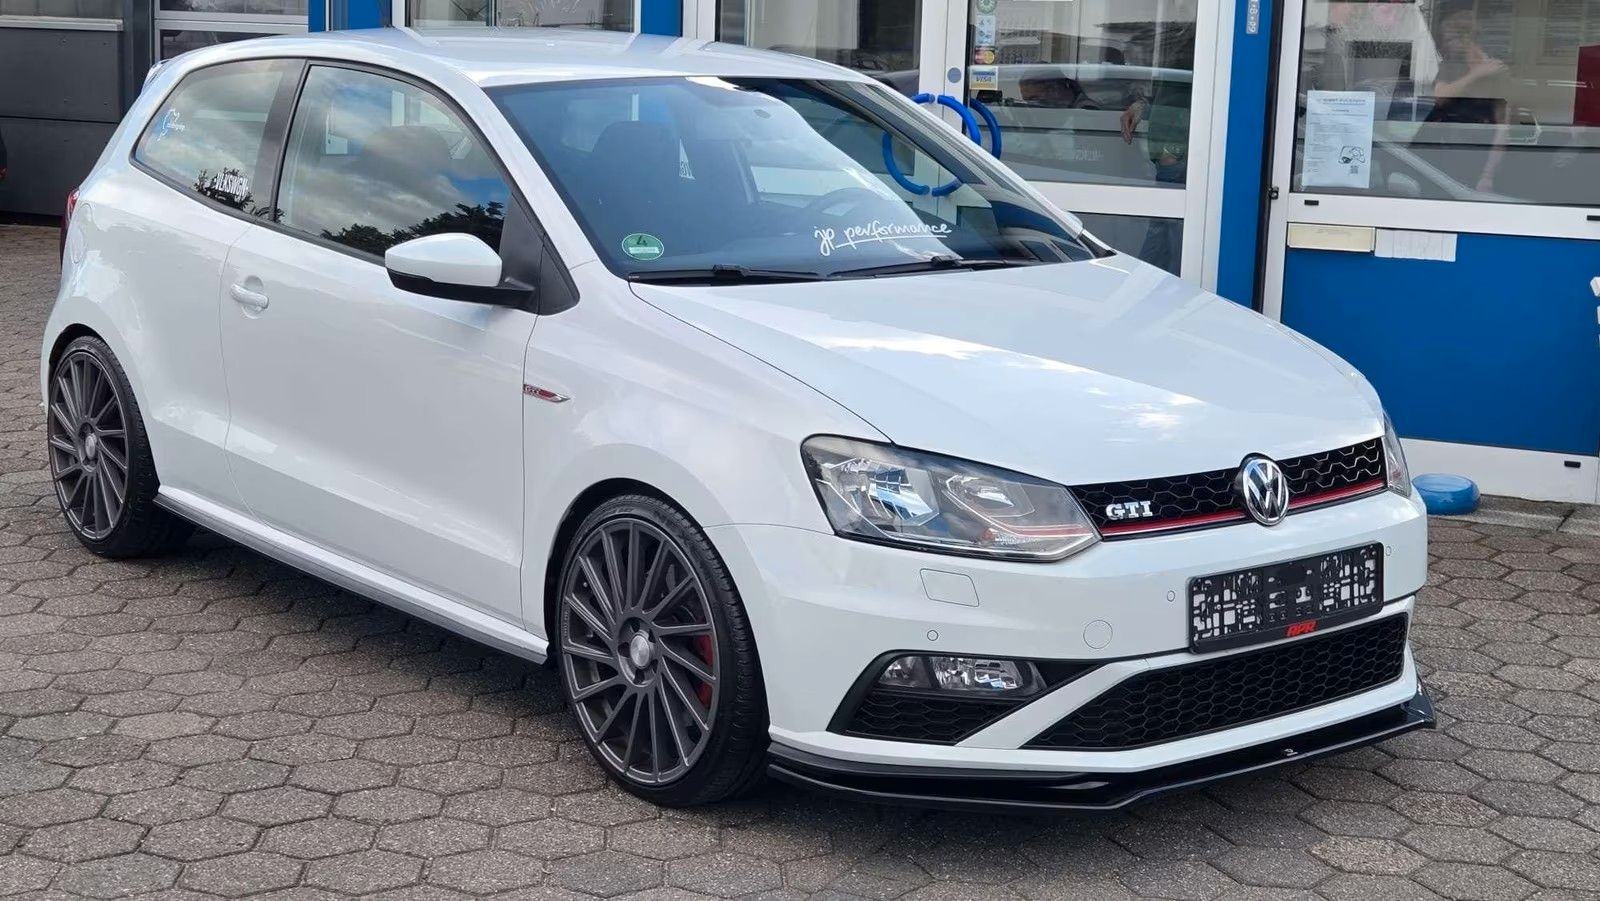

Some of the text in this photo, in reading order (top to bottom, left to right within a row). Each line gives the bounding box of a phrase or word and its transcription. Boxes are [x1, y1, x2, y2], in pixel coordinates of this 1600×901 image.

[636, 235, 648, 246] 4
[845, 221, 952, 243] performance
[1105, 500, 1153, 520] GTI
